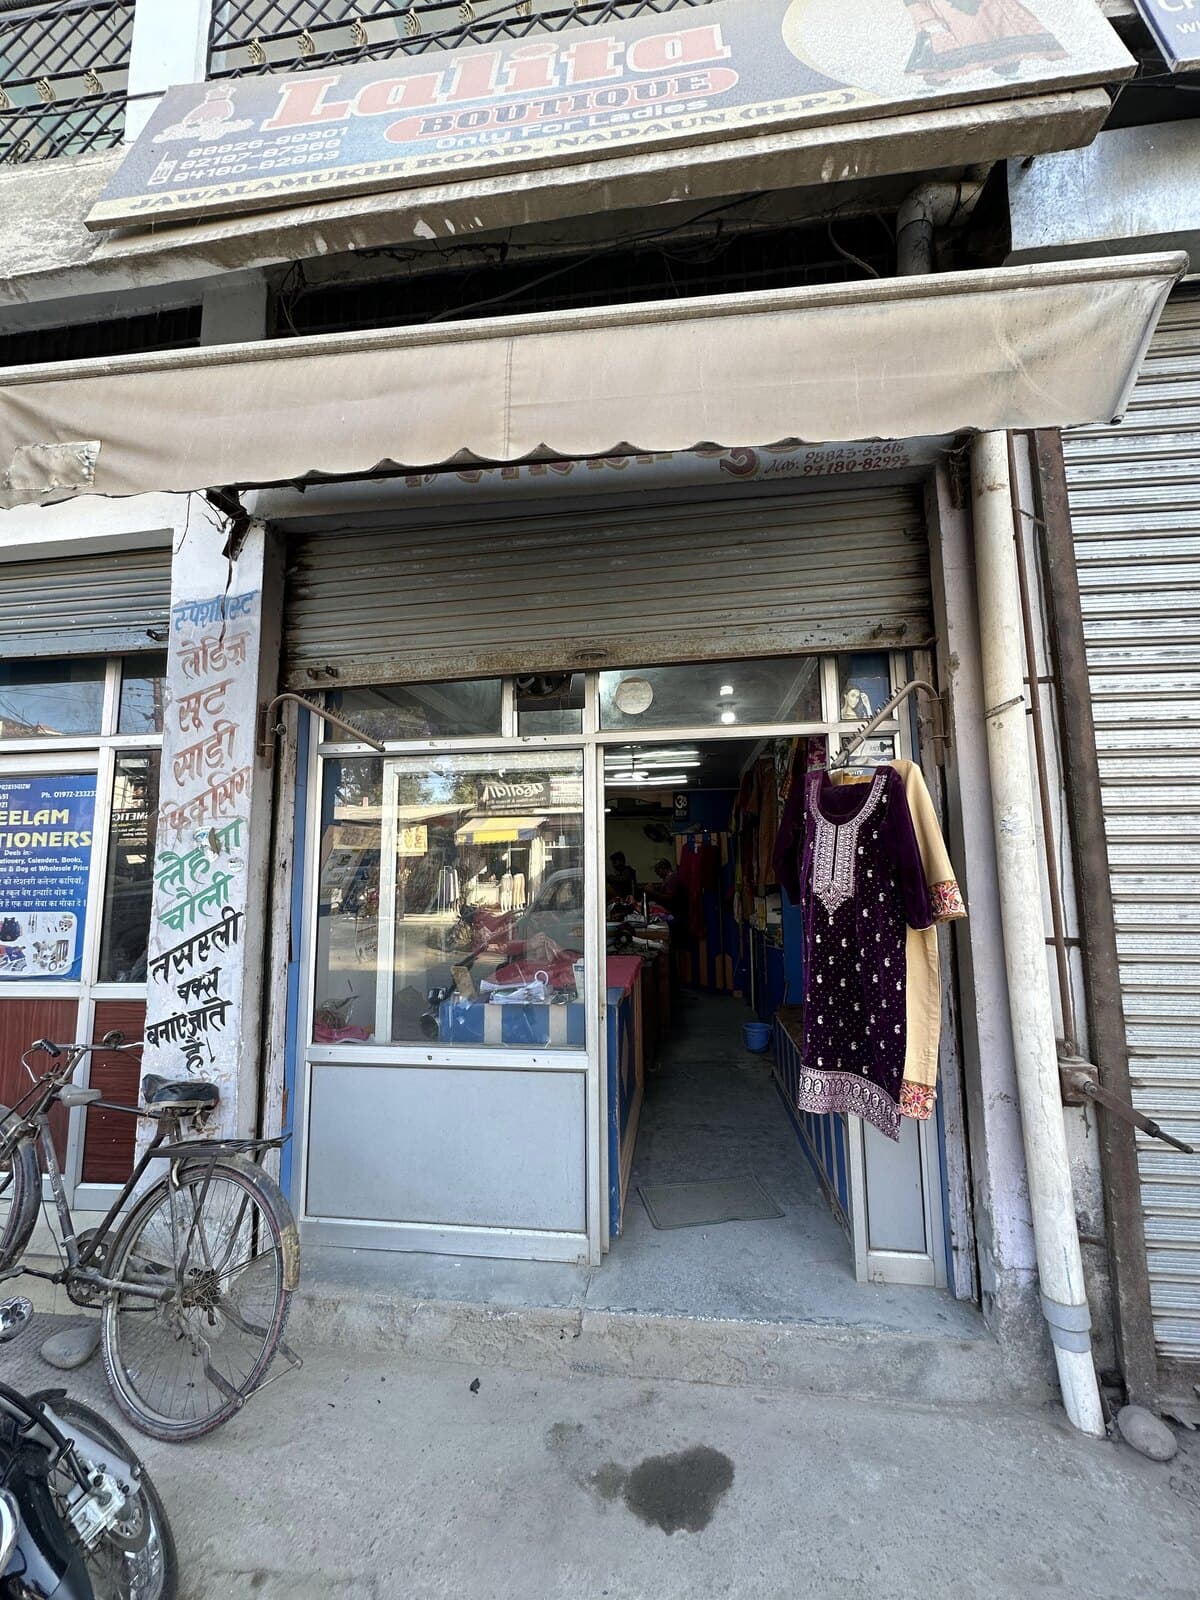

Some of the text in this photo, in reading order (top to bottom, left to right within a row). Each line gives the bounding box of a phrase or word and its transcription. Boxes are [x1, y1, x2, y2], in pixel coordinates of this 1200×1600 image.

[261, 23, 732, 132] Lalita
[416, 72, 711, 136] BOUTIQUE
[436, 98, 710, 149] Only For Ladies
[130, 160, 409, 211] JAWALAMUKHI
[553, 113, 726, 147] NADAUN
[175, 677, 236, 733] सूट
